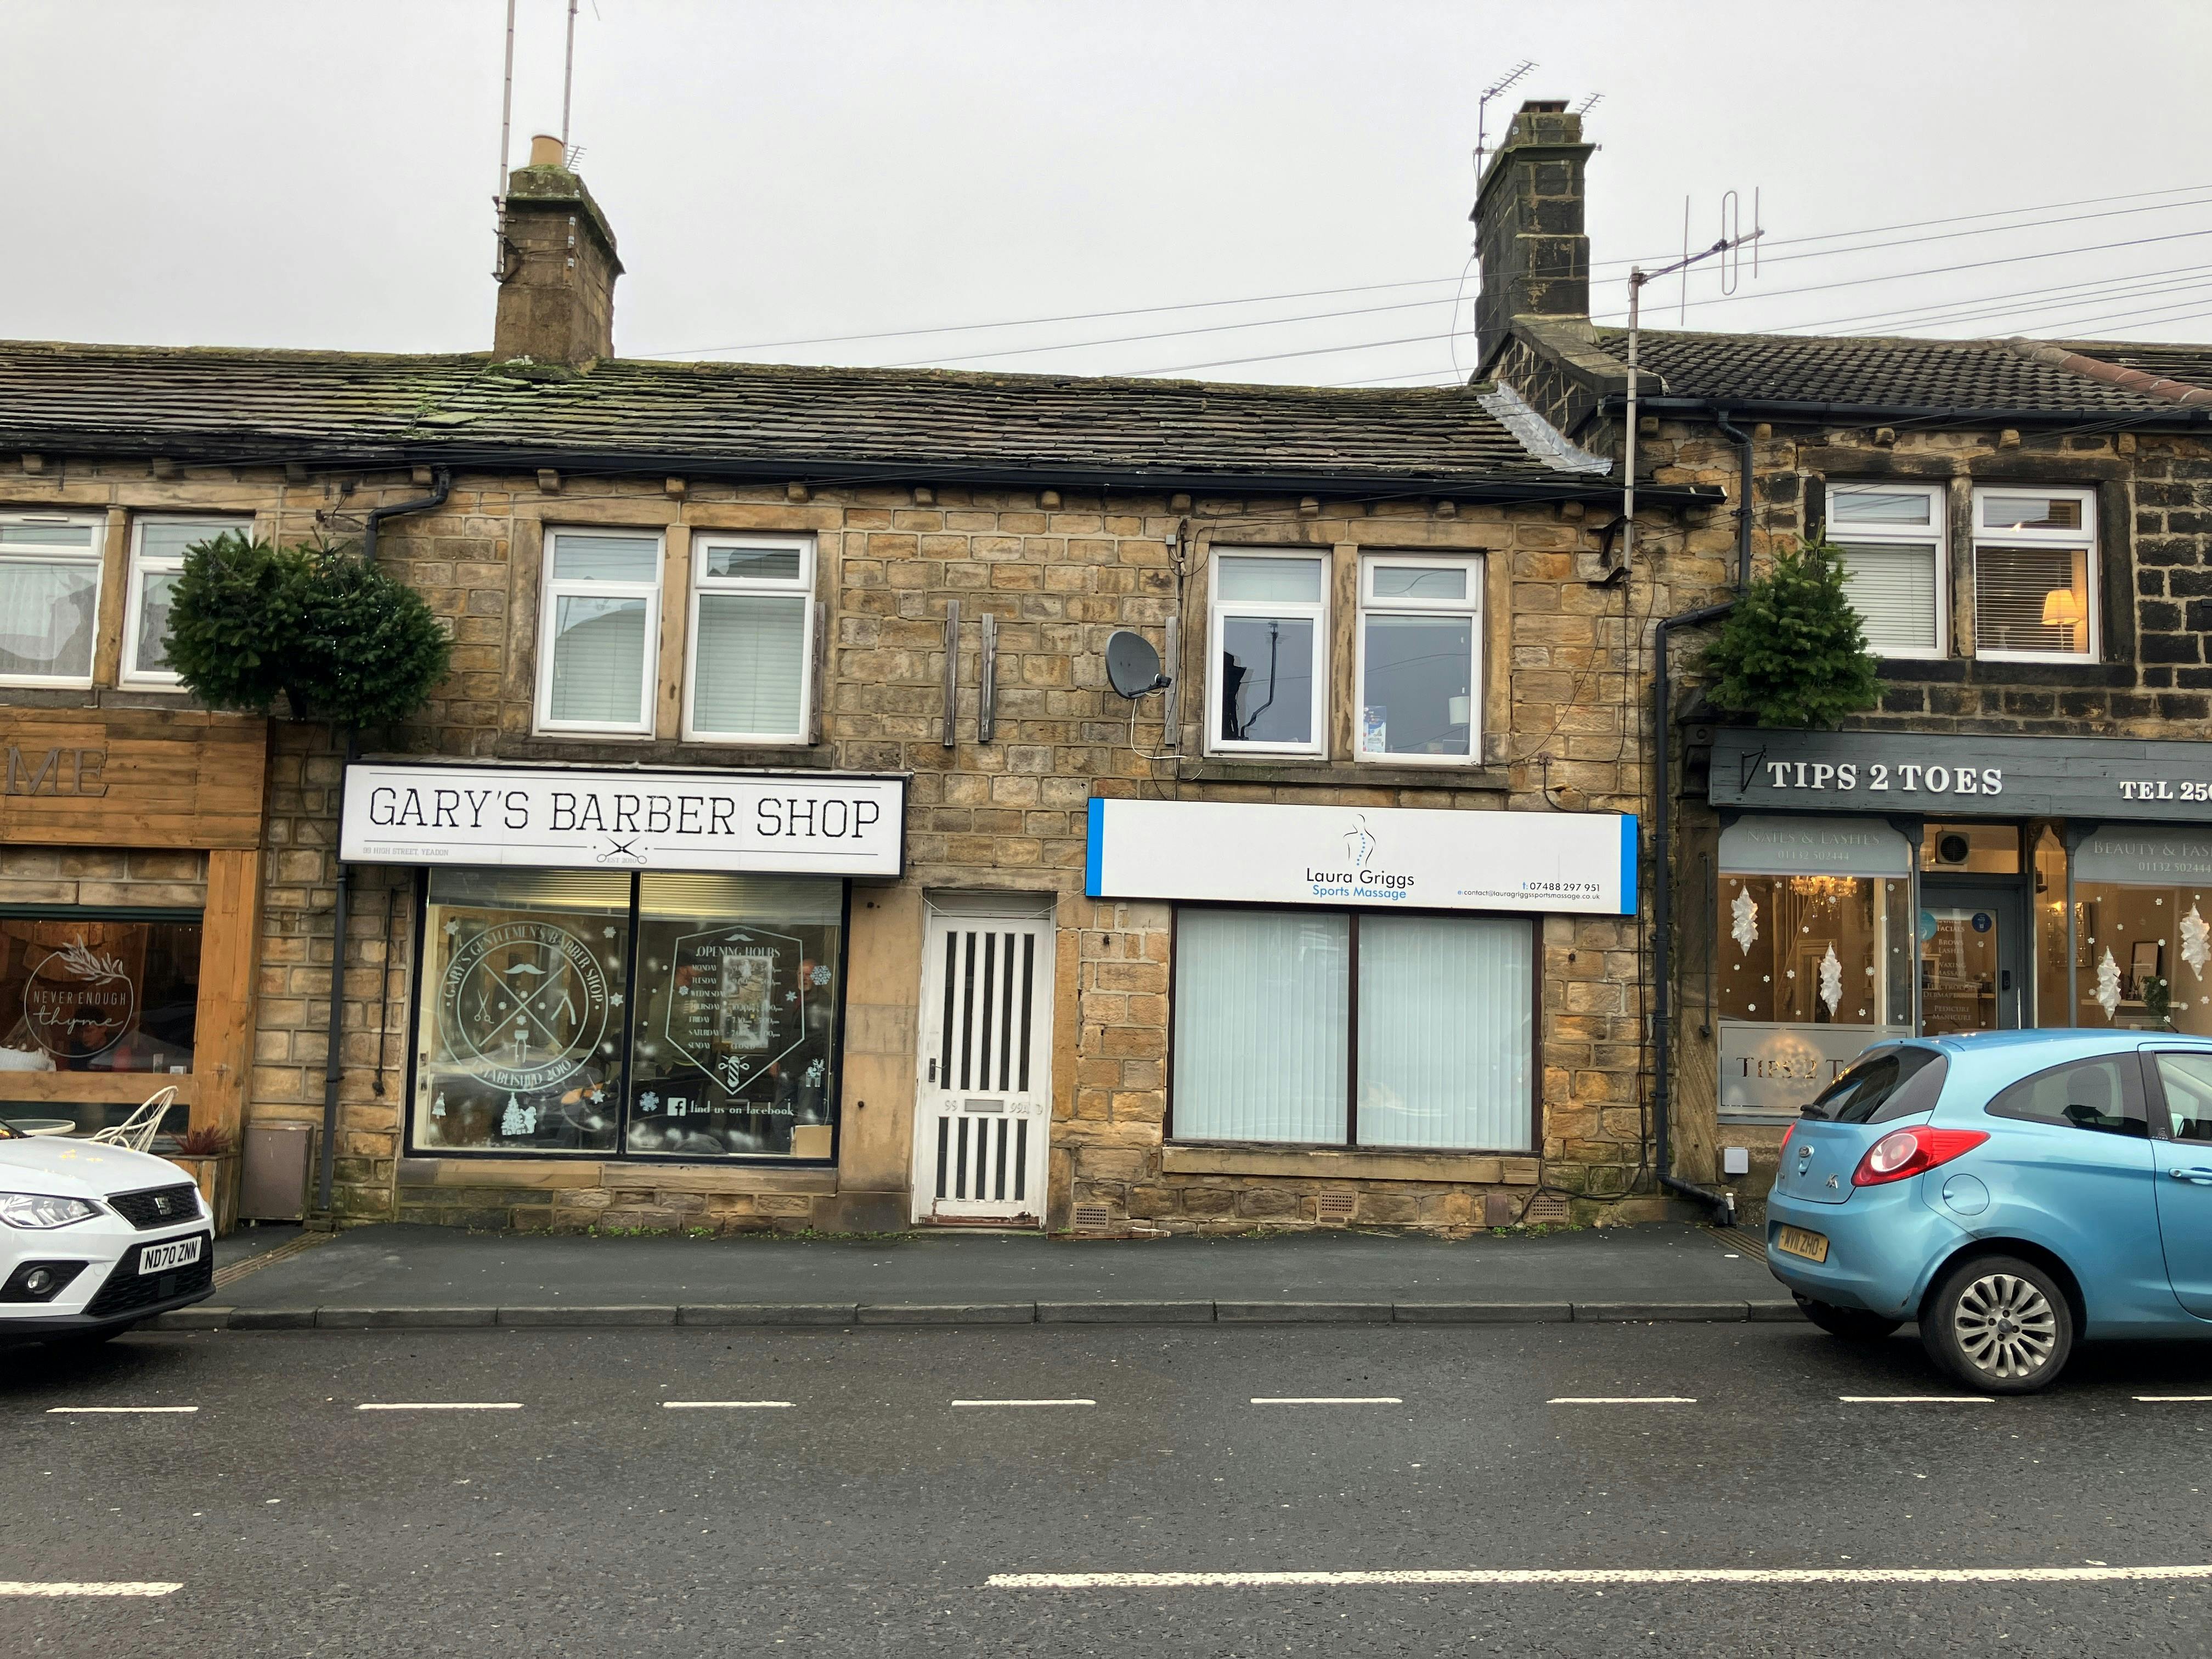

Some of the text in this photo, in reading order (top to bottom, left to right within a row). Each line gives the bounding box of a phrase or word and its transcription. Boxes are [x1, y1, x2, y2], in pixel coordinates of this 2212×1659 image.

[1767, 762, 2003, 795] TIPS 2 TOES
[2119, 781, 2174, 799] TEL
[369, 787, 879, 838] GARY'S BARBER SHOP
[1746, 828, 1881, 845] NAILS & LASHES
[392, 848, 419, 856] STREET,
[1778, 850, 1849, 861] 01132 502444
[2094, 840, 2212, 857] BEAUTY & FAS
[2138, 862, 2211, 873] 01132 502444
[1306, 867, 1415, 889] Laura Griggs
[1312, 884, 1407, 901] Sports Massage
[1530, 882, 1561, 891] 07488
[1563, 883, 1581, 891] 297
[1584, 884, 1600, 892] 951
[696, 946, 781, 957] OPENING HOURS
[444, 925, 603, 1002] GARY'S GENTLEMEN'S BARBER SHOP
[33, 990, 126, 1006] NEVER ENOUGH
[33, 1005, 124, 1035] thyme
[546, 1059, 572, 1081] 2010
[1736, 1057, 1793, 1079] TIPS
[1804, 1058, 1817, 1079] 2
[746, 1101, 794, 1116] facebook
[144, 1240, 198, 1270] ND70 ZNN
